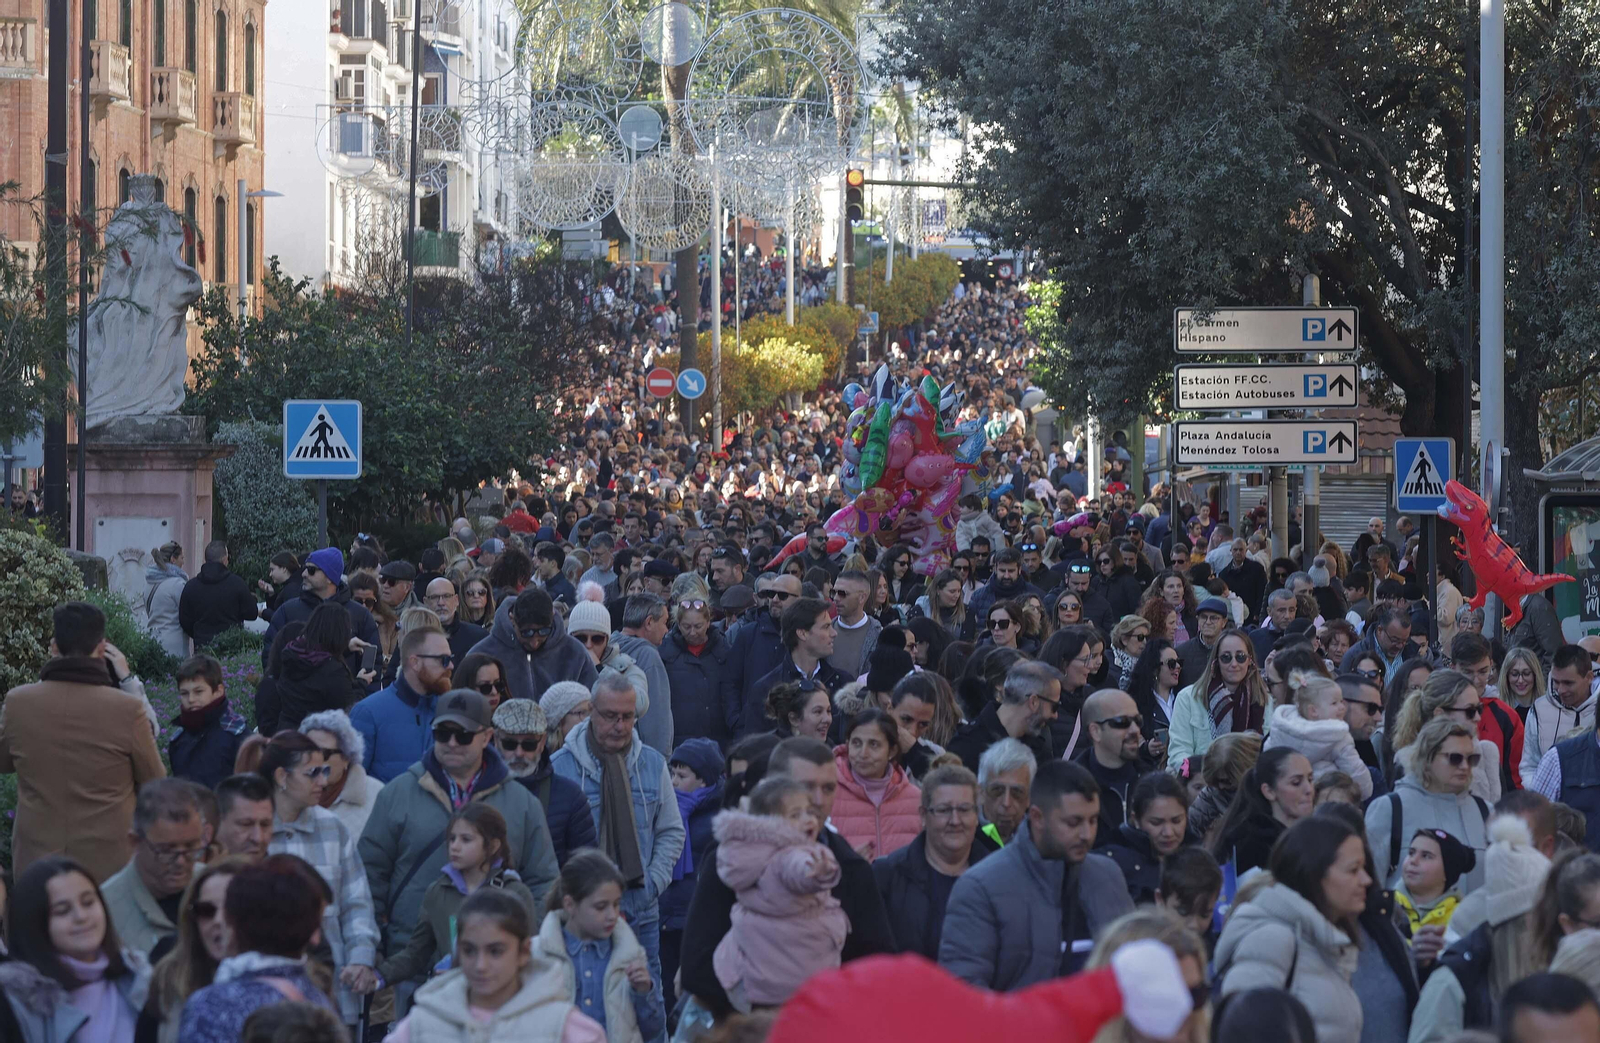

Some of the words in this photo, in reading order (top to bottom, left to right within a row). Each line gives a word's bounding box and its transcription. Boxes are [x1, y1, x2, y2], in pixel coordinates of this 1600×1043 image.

[1307, 320, 1323, 340] P
[1179, 333, 1226, 344] Hispano
[1181, 375, 1230, 386] Estación
[1234, 374, 1272, 385] FF.CC.
[1308, 376, 1324, 396] P
[1181, 389, 1230, 400] Estación
[1235, 389, 1296, 400] Autobuses
[1180, 430, 1210, 441] Plaza
[1215, 430, 1272, 441] Andalucía
[1308, 432, 1323, 452] P
[1180, 444, 1237, 455] Menéndez
[1241, 444, 1280, 455] Tolosa
